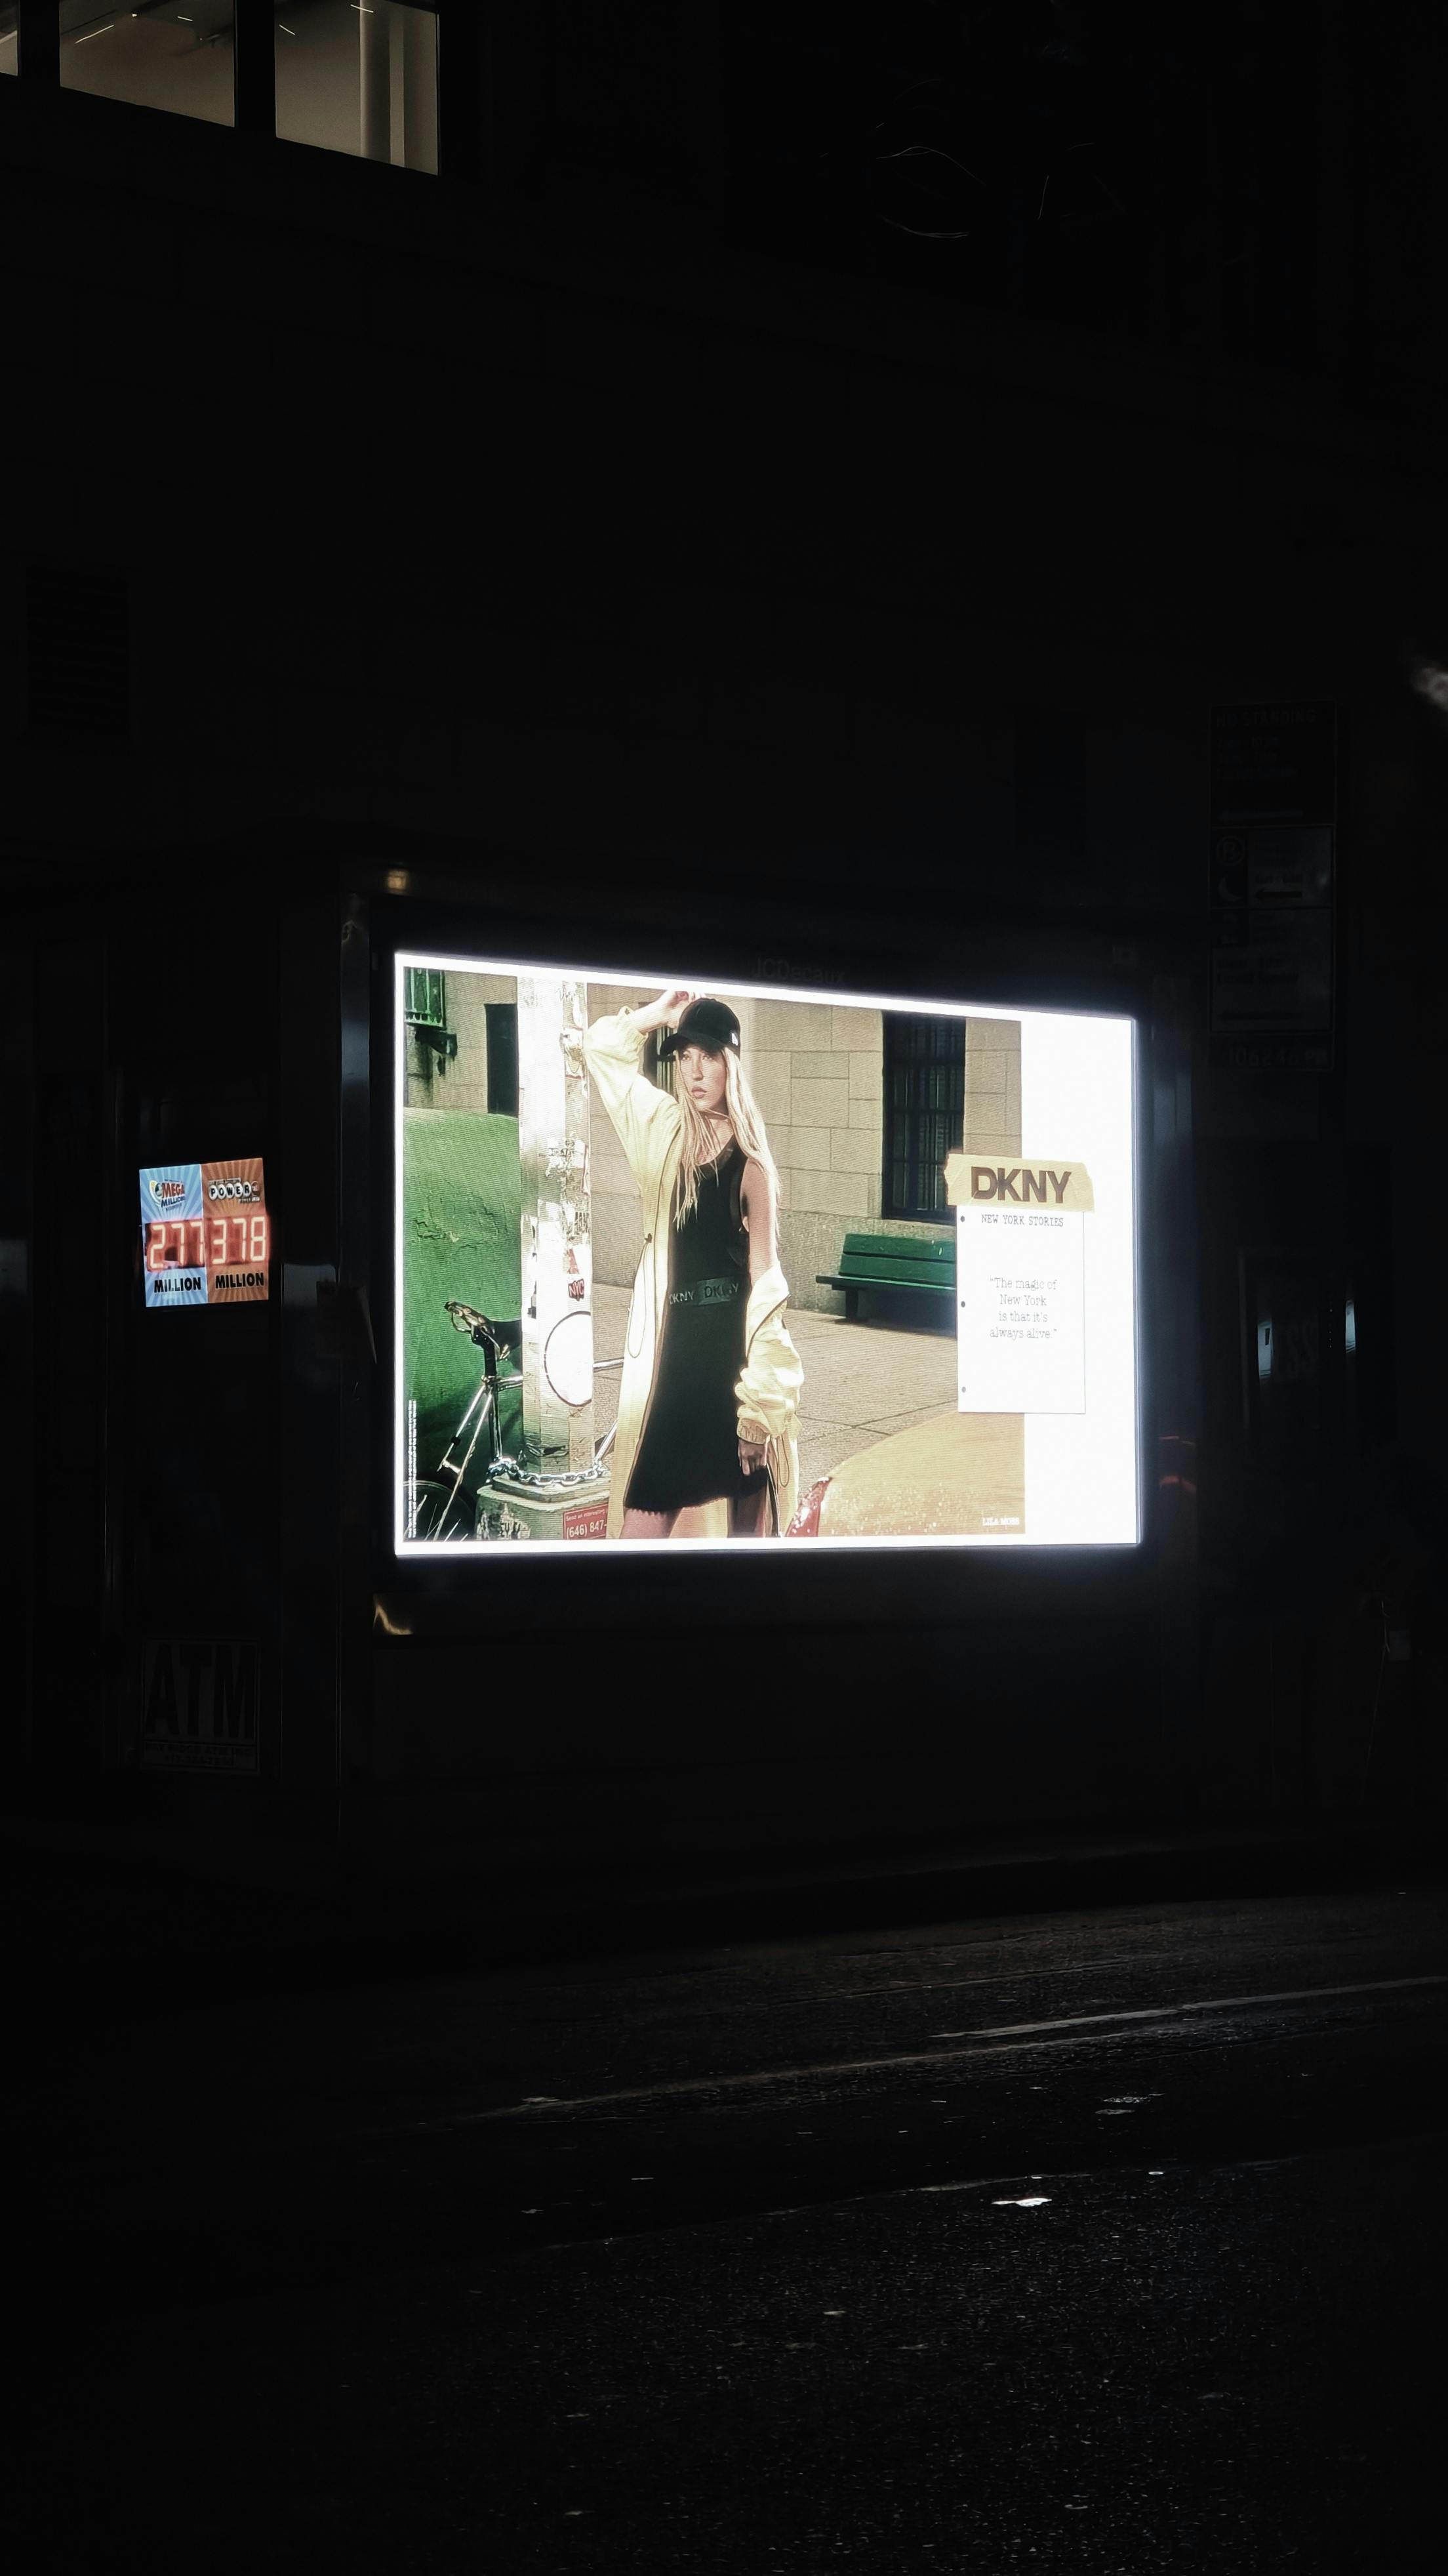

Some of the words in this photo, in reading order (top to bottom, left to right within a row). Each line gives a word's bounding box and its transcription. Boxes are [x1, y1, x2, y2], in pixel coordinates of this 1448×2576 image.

[161, 1182, 186, 1199] MEGA
[210, 1185, 251, 1199] POWER
[971, 1166, 1072, 1204] DKNY
[981, 1214, 999, 1223] NEW
[1002, 1215, 1025, 1225] YORK
[1028, 1216, 1064, 1227] STORIES
[150, 1220, 204, 1269] 277
[211, 1216, 266, 1265] 378
[153, 1277, 202, 1294] MILLION
[215, 1272, 264, 1289] MILLION
[1015, 1280, 1045, 1292] magic
[1047, 1279, 1058, 1290] of
[569, 1280, 584, 1301] NYC
[999, 1294, 1021, 1305] New
[1024, 1295, 1047, 1306] York
[998, 1311, 1007, 1321] is
[1009, 1310, 1031, 1322] that
[1034, 1312, 1049, 1322] it's
[989, 1326, 1024, 1341] always
[566, 1523, 588, 1540] (646)
[145, 1643, 256, 1740] ATM
